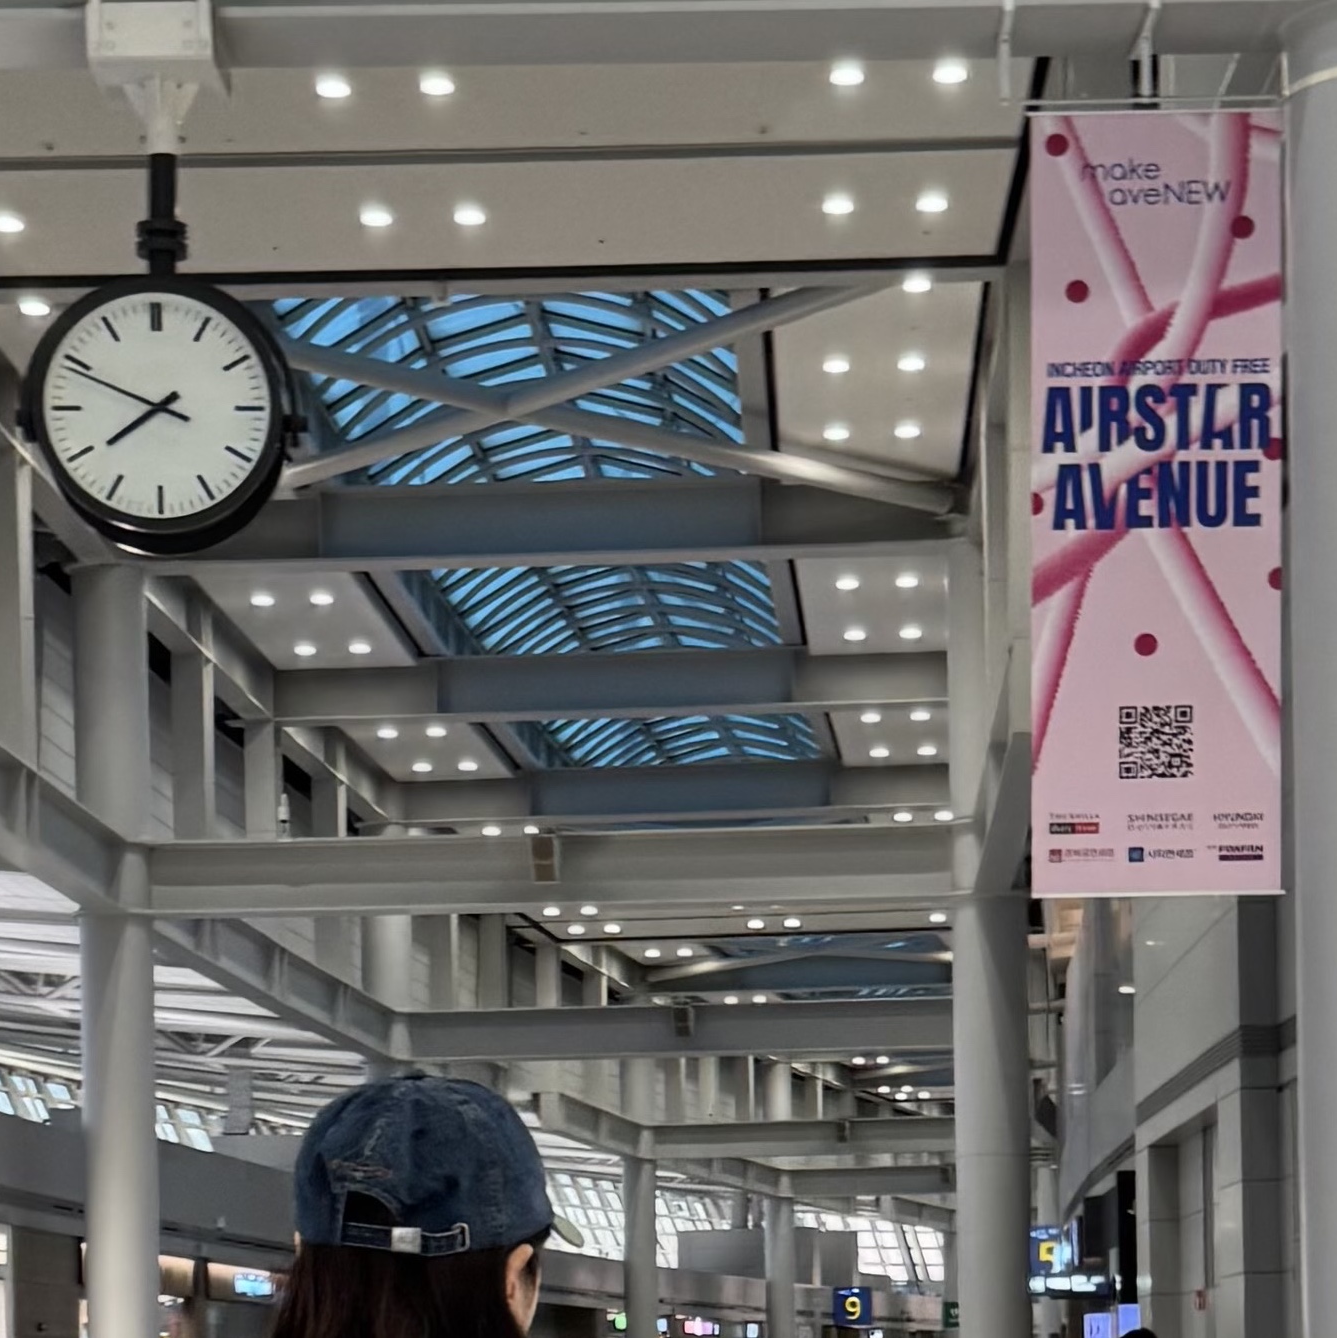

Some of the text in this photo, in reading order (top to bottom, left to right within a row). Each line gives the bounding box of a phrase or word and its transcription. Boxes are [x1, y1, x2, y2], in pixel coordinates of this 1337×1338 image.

[1080, 159, 1161, 182] make
[1046, 358, 1271, 378] INCHEON AIRPORT DUTY FREE
[1042, 382, 1272, 454] AIRSTAR
[1052, 460, 1263, 531] AVENUE
[845, 1296, 861, 1320] 9
